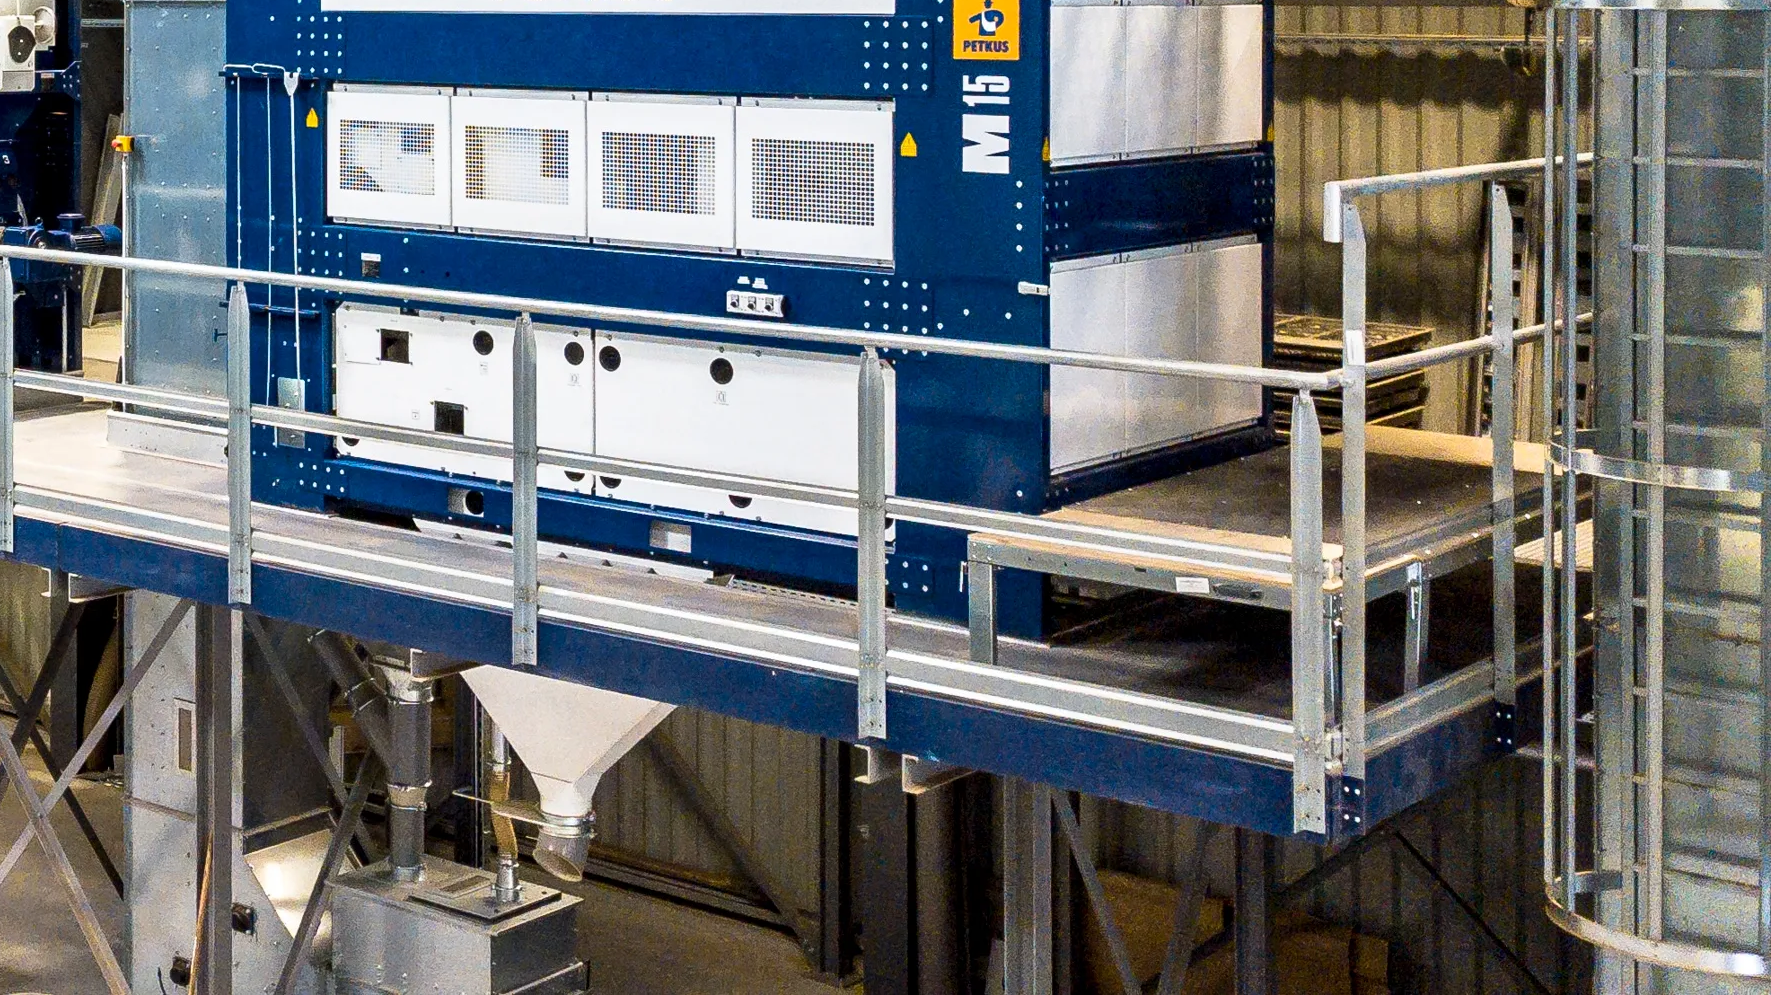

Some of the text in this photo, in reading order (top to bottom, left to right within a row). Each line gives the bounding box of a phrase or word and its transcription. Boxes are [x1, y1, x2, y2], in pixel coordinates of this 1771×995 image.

[963, 40, 1009, 53] PETKUS
[962, 74, 1011, 174] M 15
